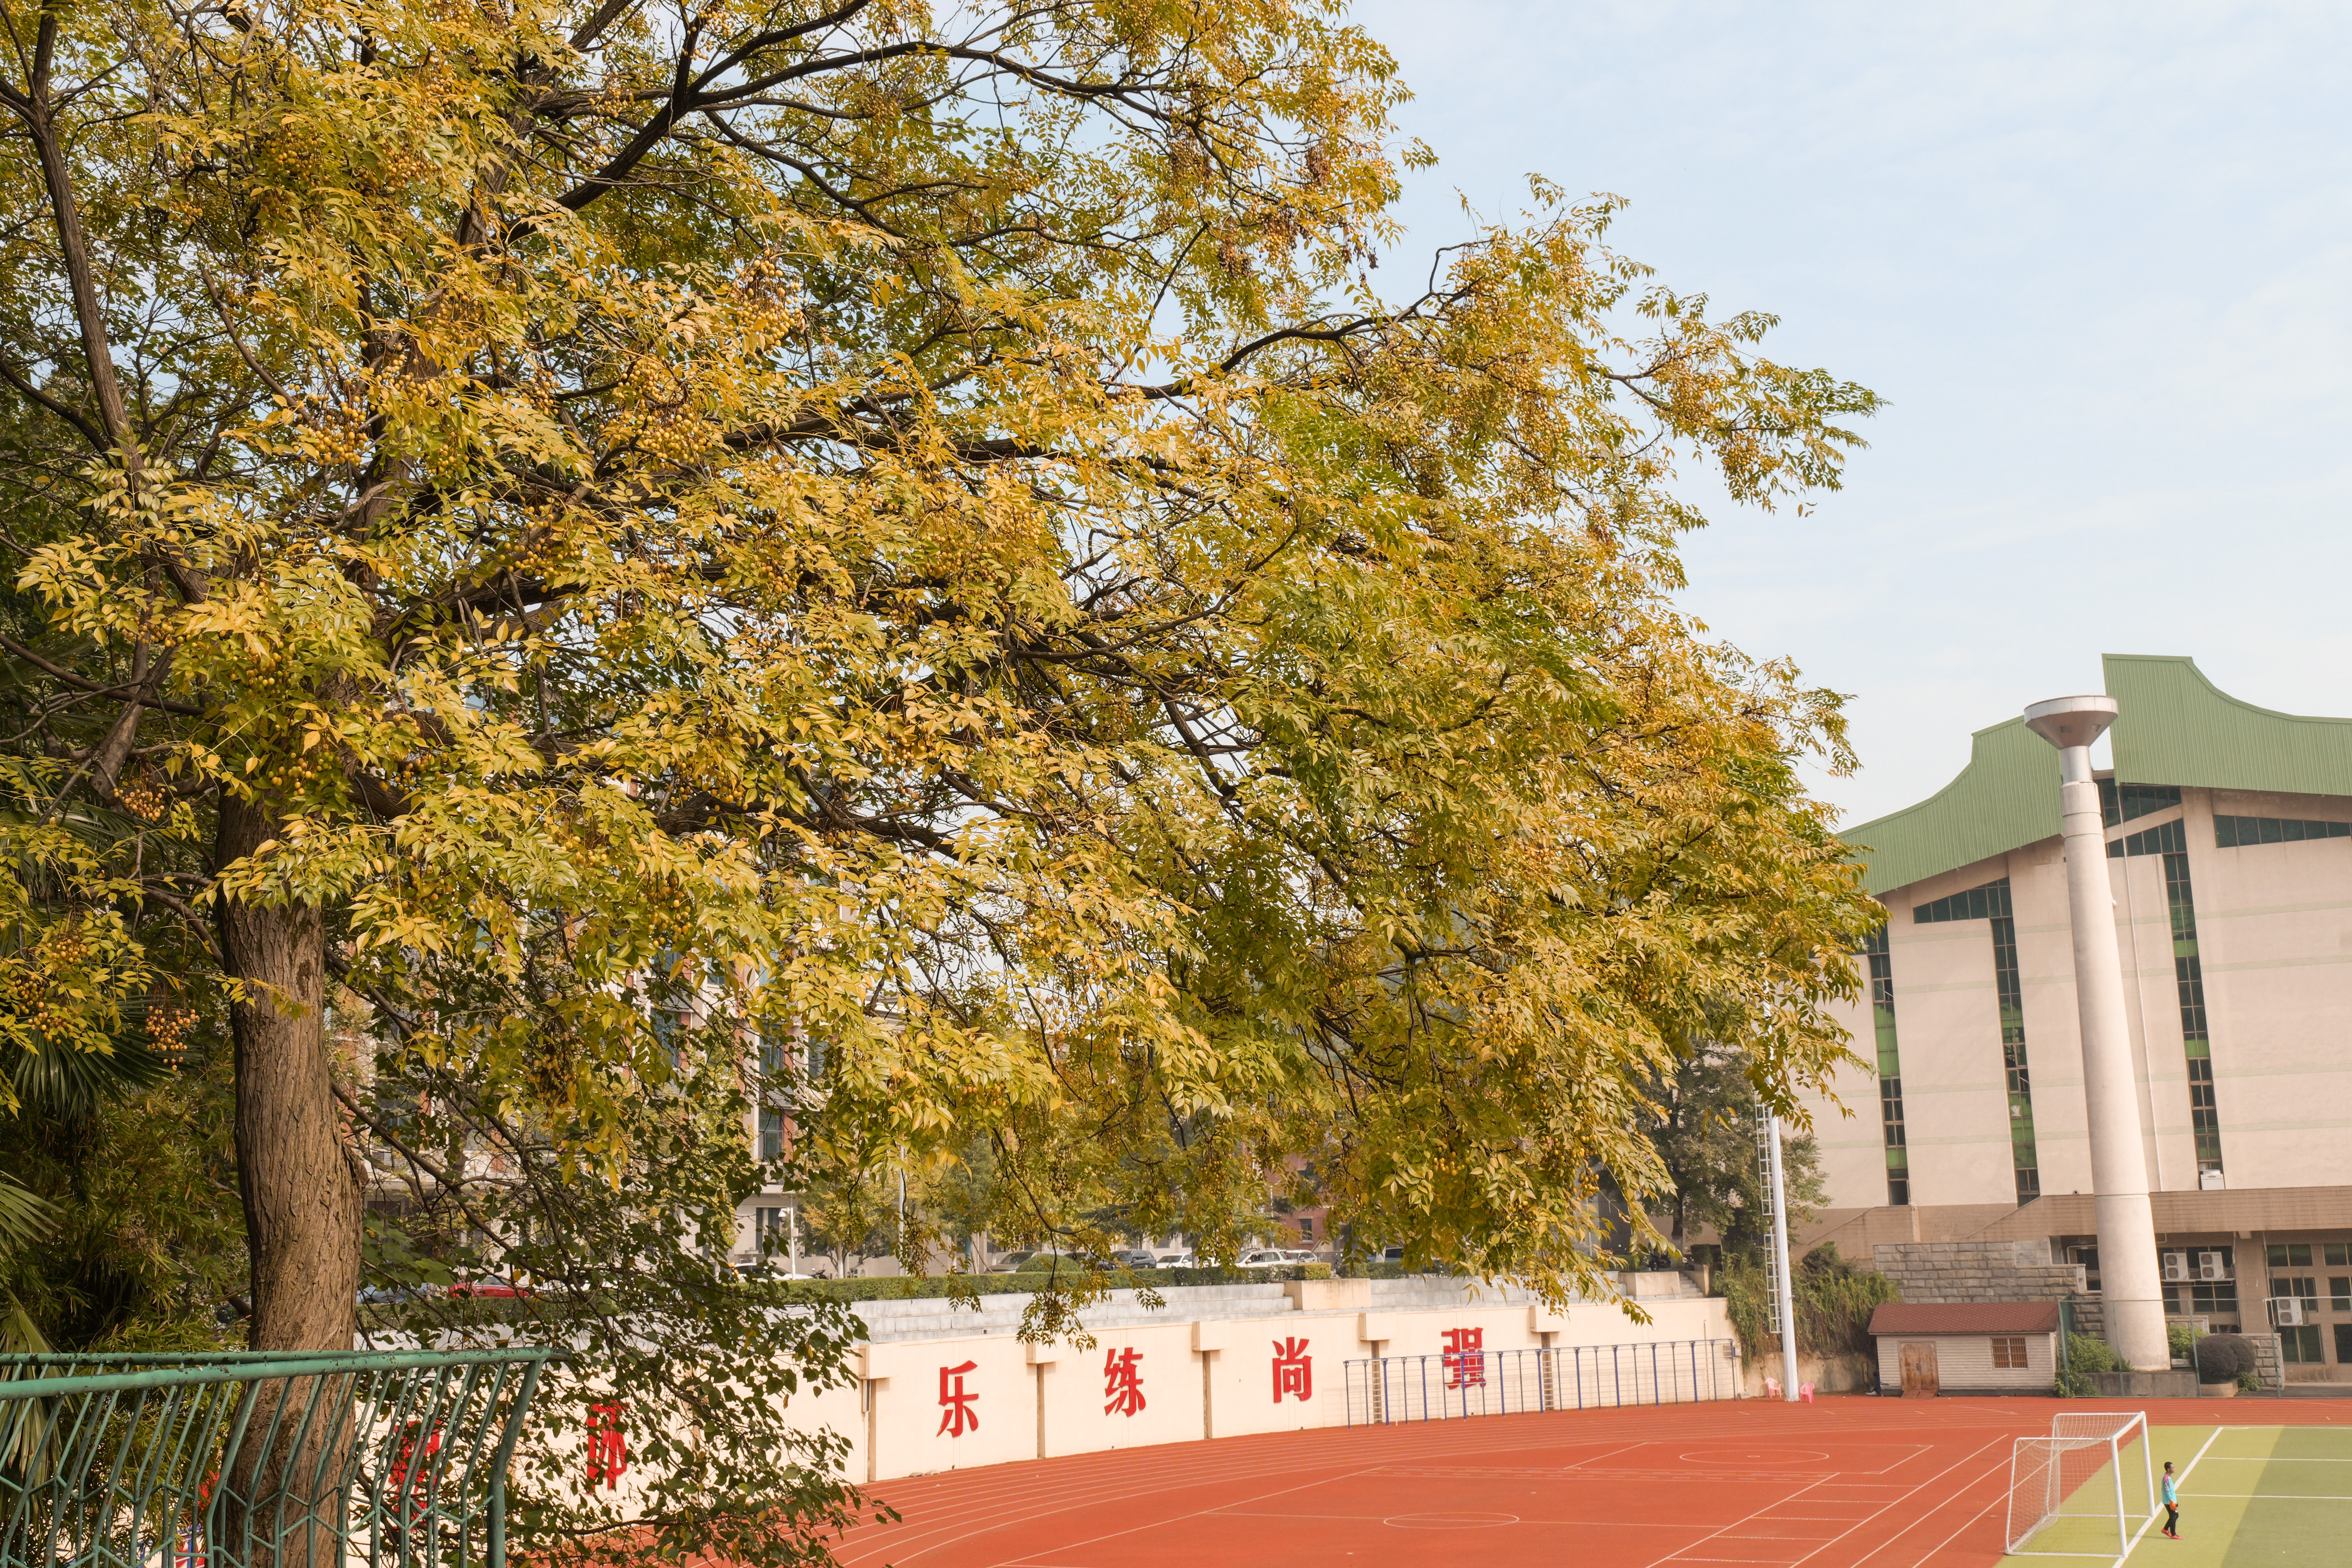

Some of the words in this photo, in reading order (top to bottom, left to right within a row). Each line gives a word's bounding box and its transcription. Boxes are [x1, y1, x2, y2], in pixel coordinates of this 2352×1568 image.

[936, 1360, 979, 1438] 乐
[1104, 1347, 1146, 1417] 练
[1272, 1337, 1312, 1403] 尚
[1441, 1327, 1486, 1390] 强
